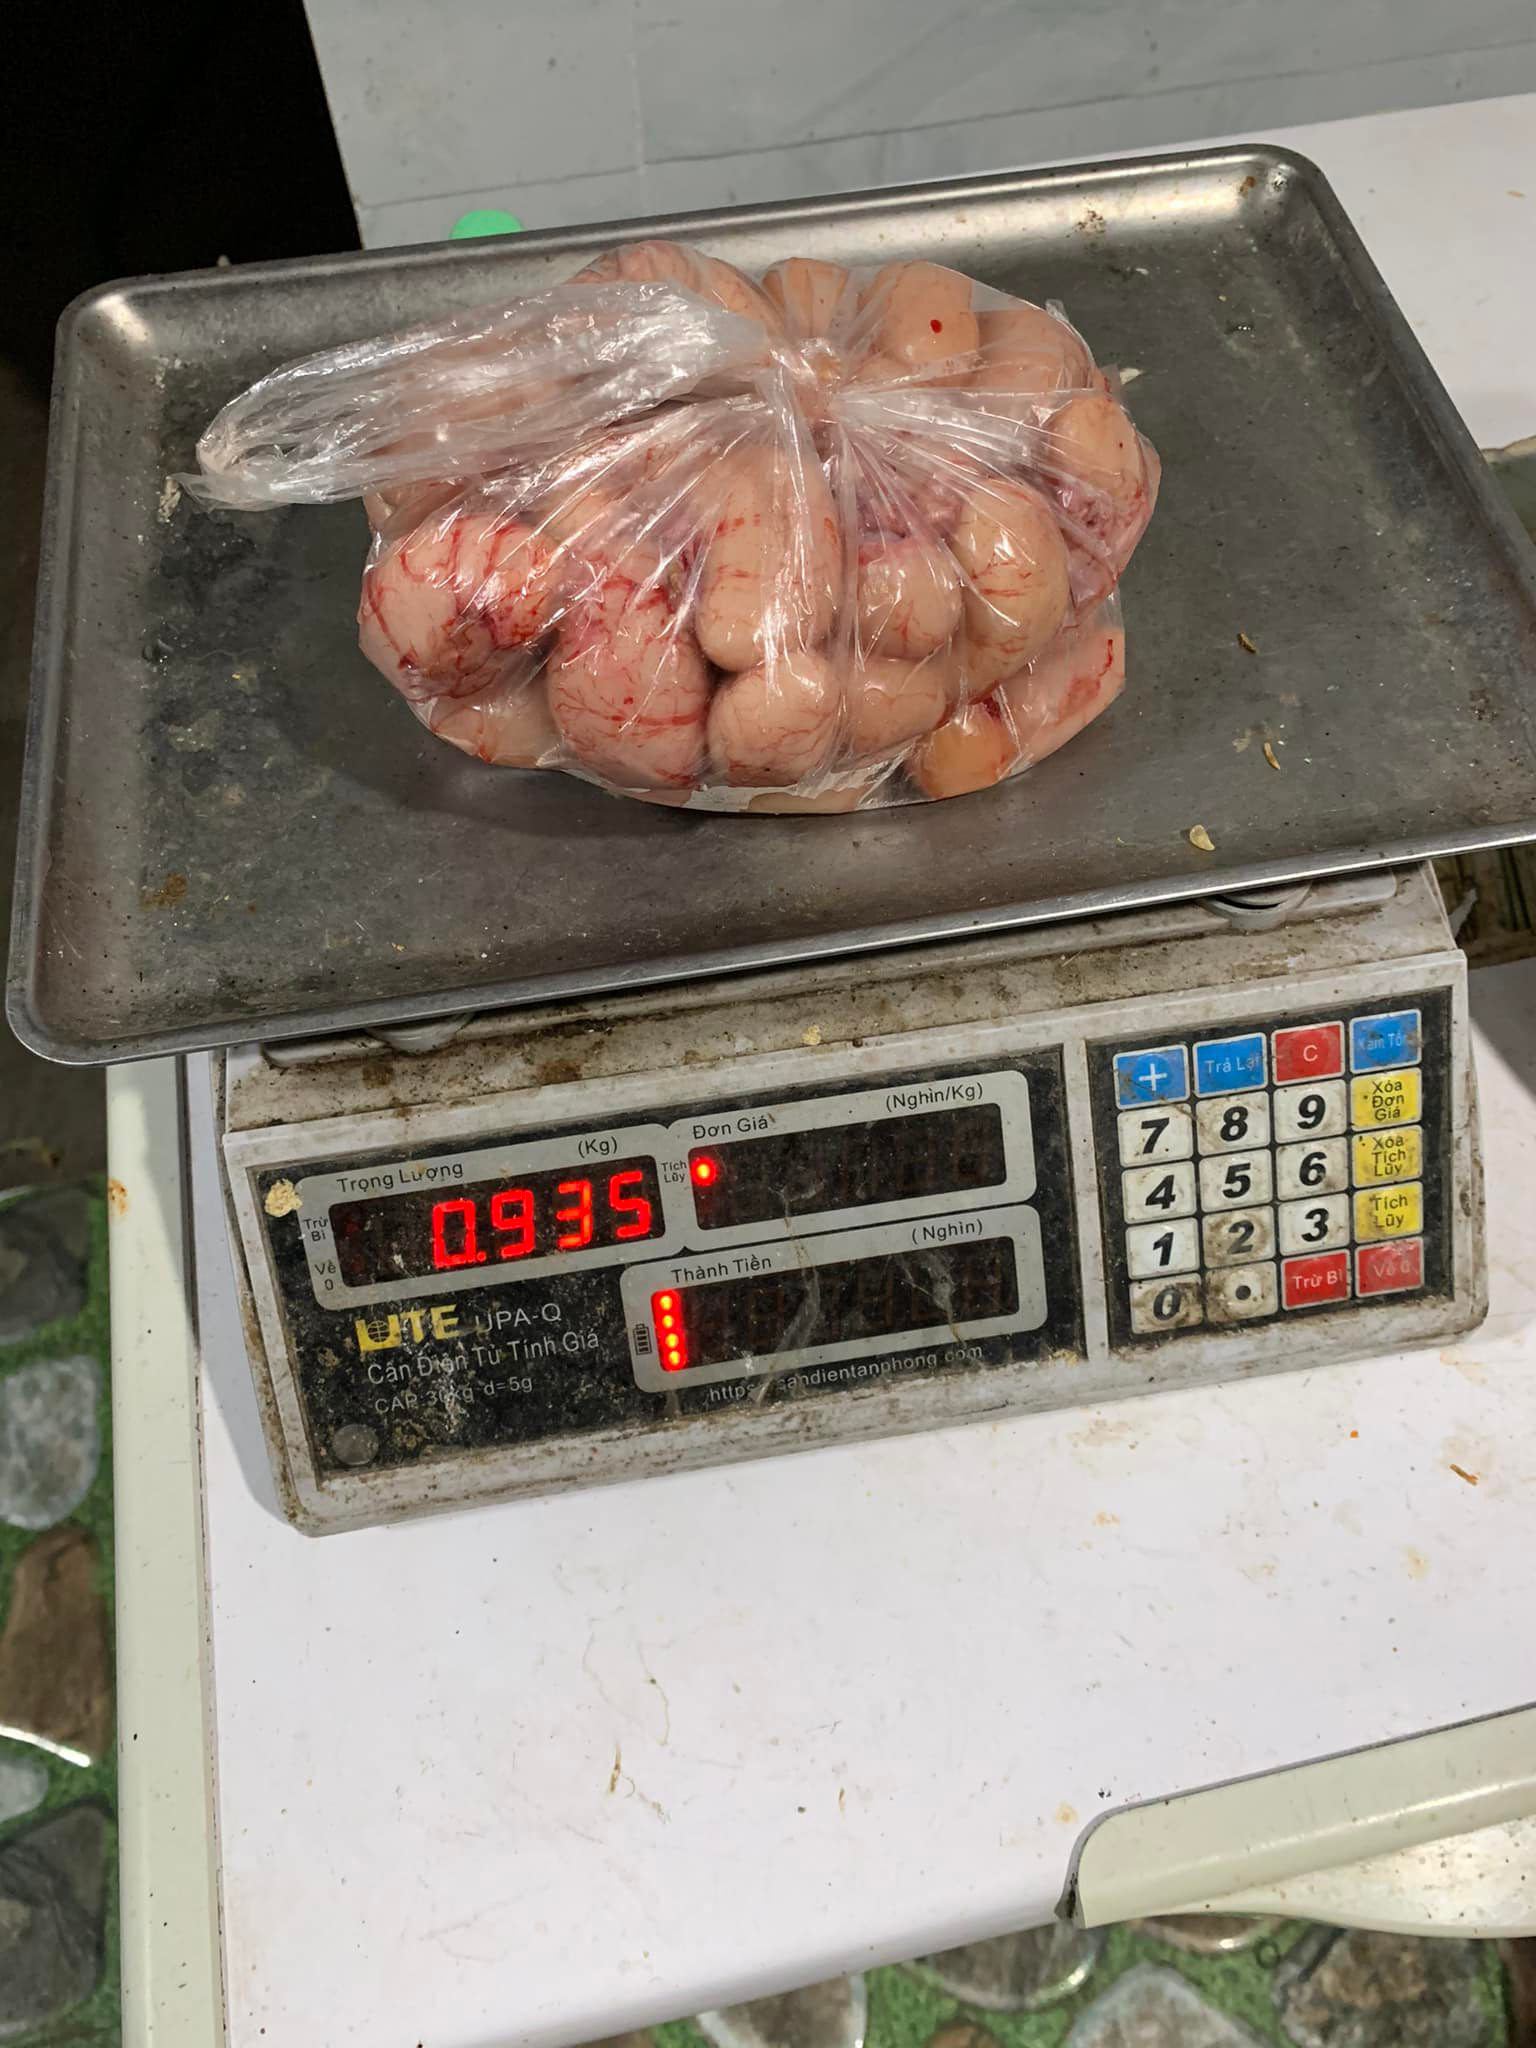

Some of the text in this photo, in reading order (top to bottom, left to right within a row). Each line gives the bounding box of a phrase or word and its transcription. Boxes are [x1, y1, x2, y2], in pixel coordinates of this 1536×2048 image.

[1205, 1056, 1232, 1073] Trả
[1303, 1044, 1319, 1062] C
[885, 1082, 984, 1113] (Nghìn/Kg)
[1371, 1094, 1405, 1109] Đơn
[1372, 1079, 1403, 1094] Xóa
[692, 1115, 769, 1140] Đơn Giá
[1219, 1105, 1249, 1142] 8
[1296, 1094, 1326, 1130] 9
[1374, 1104, 1401, 1121] Giá
[577, 1136, 618, 1158] (Kg)
[1140, 1117, 1170, 1155] 7
[1372, 1135, 1405, 1150] Xóa
[660, 1159, 687, 1173] Tích
[1299, 1151, 1328, 1186] 6
[1372, 1149, 1407, 1164] Tích
[336, 1162, 464, 1194] Trọng Lượng
[1145, 1174, 1177, 1210] 4
[1222, 1163, 1251, 1199] 5
[1373, 1194, 1409, 1211] Tích
[432, 1170, 652, 1269] 0.935
[1301, 1207, 1330, 1242] 3
[1374, 1213, 1405, 1229] Lũy
[1152, 1232, 1175, 1266] 1
[1227, 1219, 1254, 1255] 2
[671, 1253, 772, 1284] Thành Tiền
[1292, 1273, 1323, 1290] Trừ
[1153, 1288, 1181, 1321] 0
[355, 1303, 460, 1352] UTE
[471, 1343, 502, 1367] Tử
[507, 1335, 556, 1361] Tính
[561, 1328, 600, 1352] Giá
